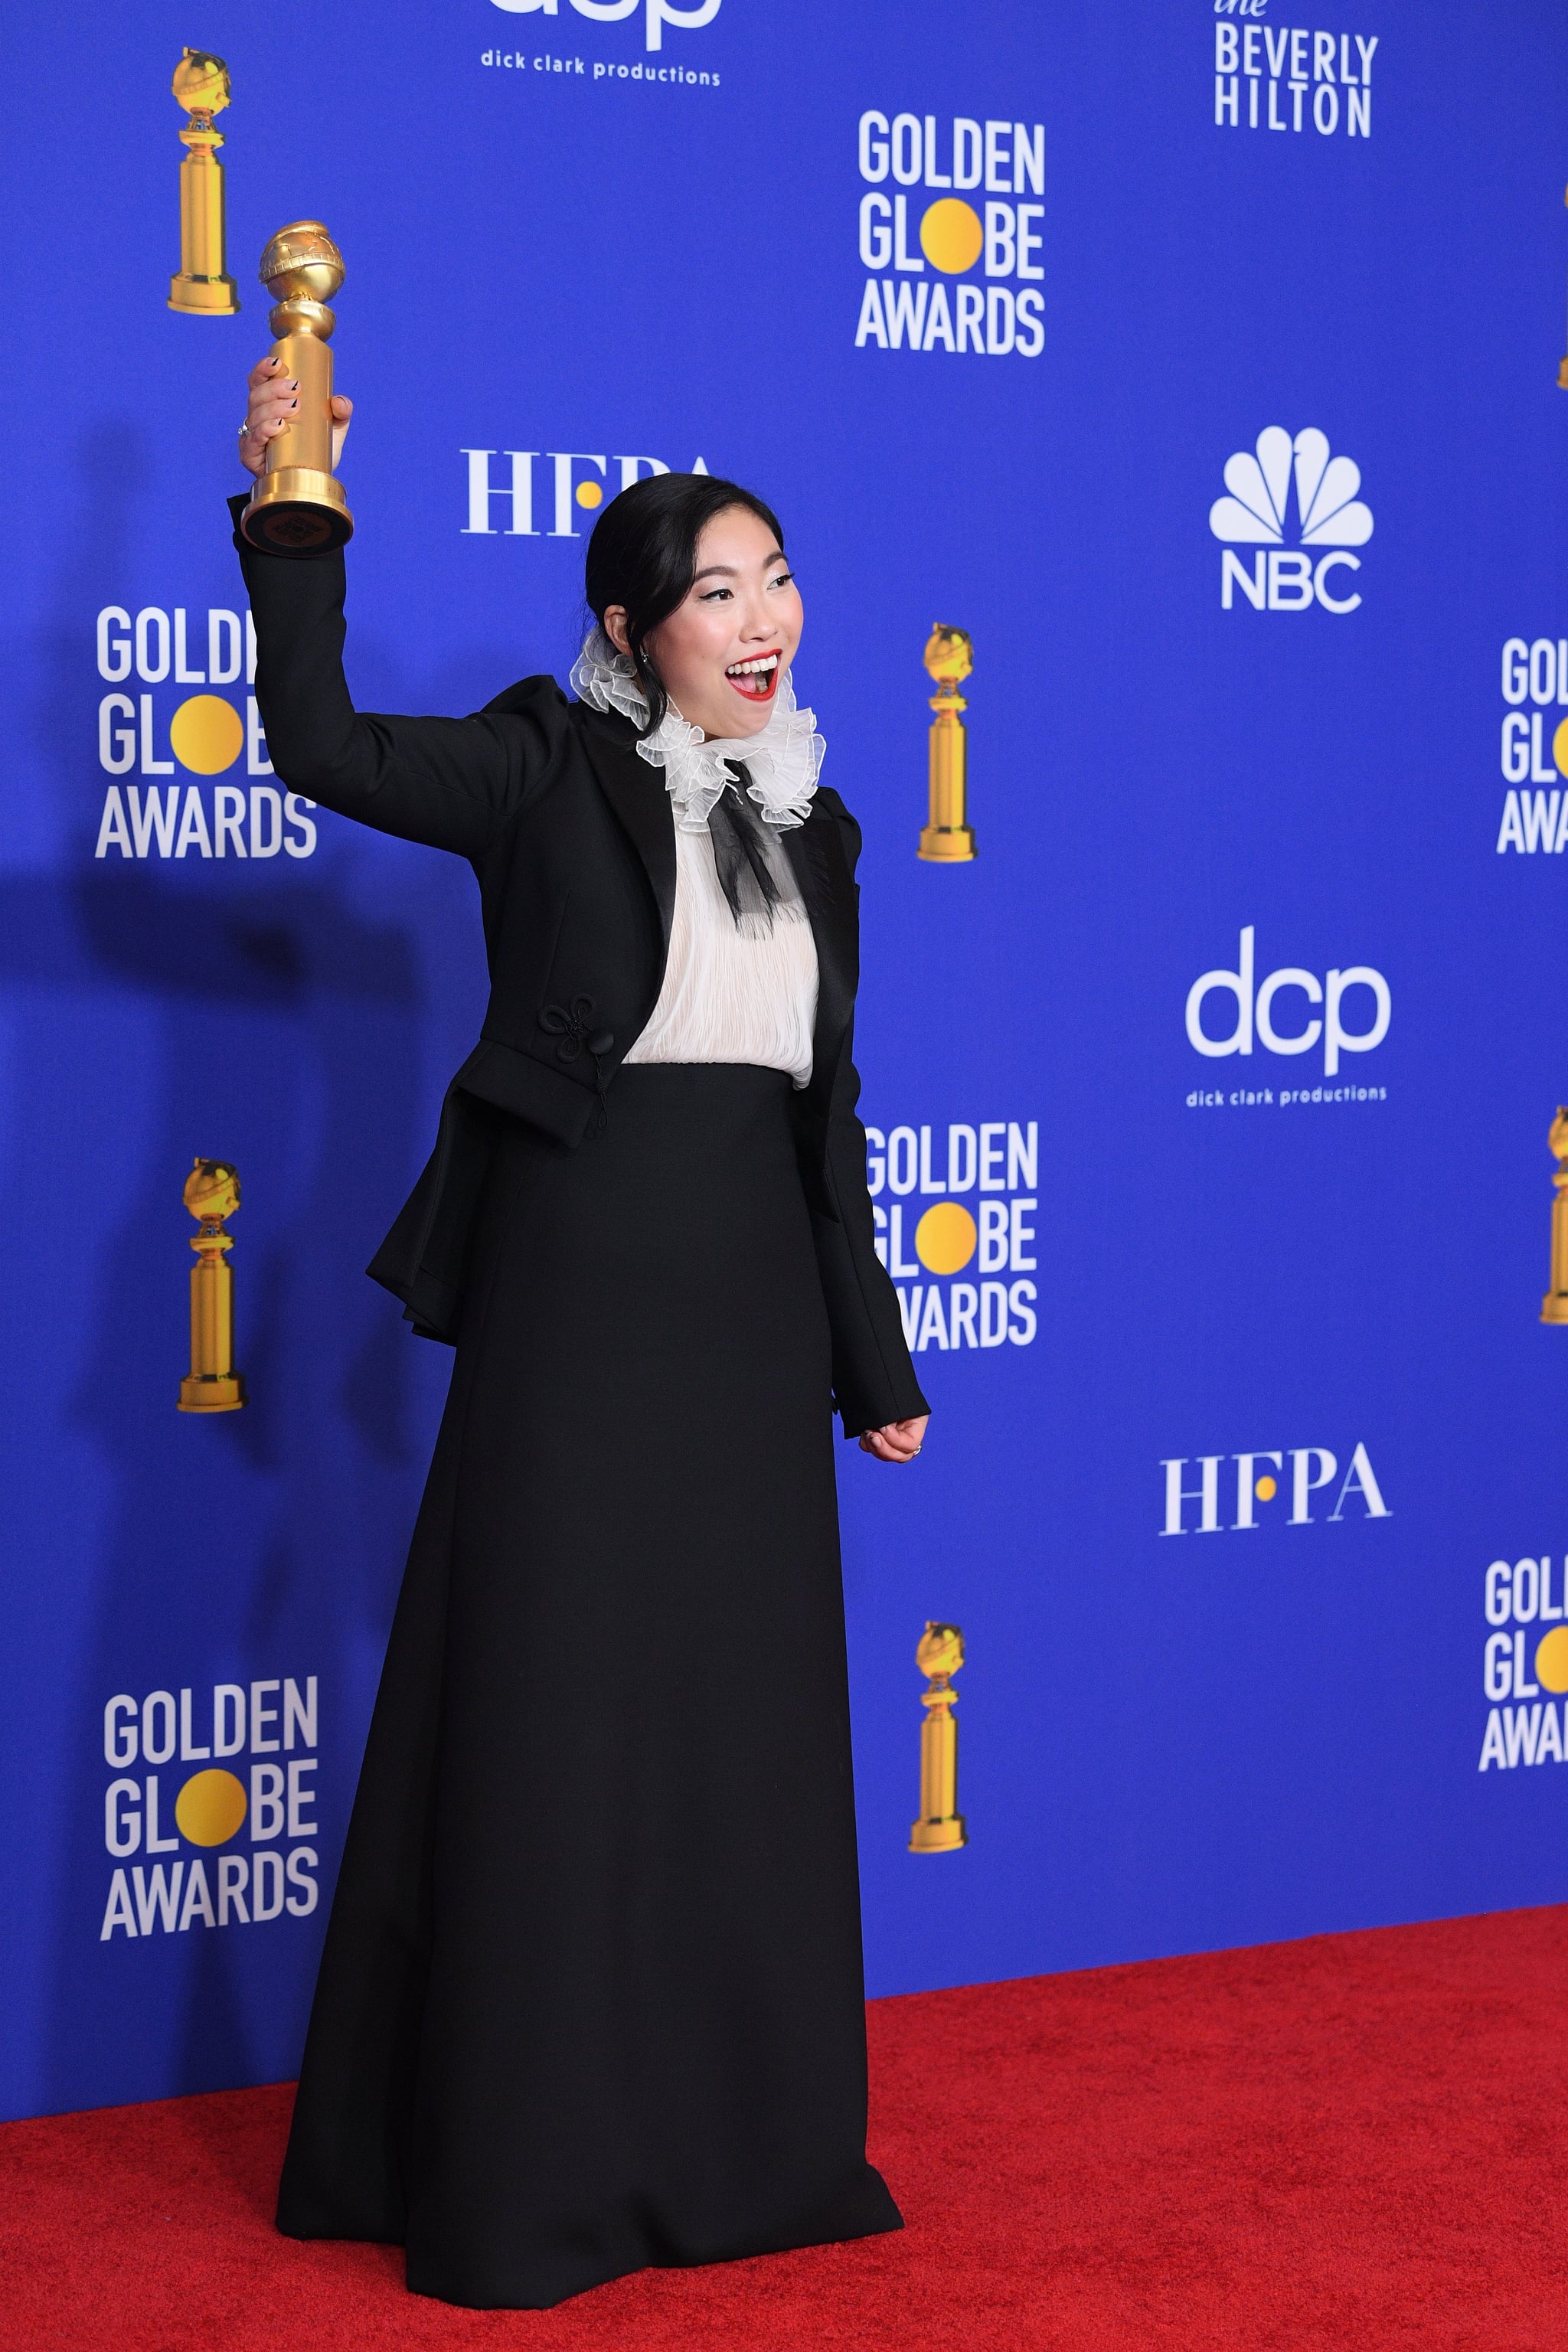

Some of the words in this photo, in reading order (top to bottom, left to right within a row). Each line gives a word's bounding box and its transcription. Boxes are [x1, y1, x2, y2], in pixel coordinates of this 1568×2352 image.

[480, 49, 525, 69] dick
[533, 55, 584, 74] clark
[593, 63, 720, 87] productions
[1215, 21, 1378, 86] BEVERLY
[1215, 74, 1370, 138] HILTON
[858, 109, 1045, 195] GOLDEN
[859, 191, 1045, 280] GLOBE
[854, 278, 1045, 358] AWARDS
[1221, 549, 1362, 614] NBC
[96, 606, 258, 684] GOLD
[95, 786, 317, 858] AWARDS
[1185, 925, 1391, 1076] dcp
[1186, 1089, 1223, 1107] dick
[1230, 1089, 1273, 1105] clark
[1280, 1086, 1387, 1107] productions
[1158, 1442, 1393, 1537] HFPA
[1485, 1554, 1568, 1625] GOL
[104, 1675, 318, 1769] GOLDEN
[1478, 1700, 1568, 1772] AWA
[105, 1759, 318, 1857] GLOBE
[100, 1846, 318, 1941] AWARDS
